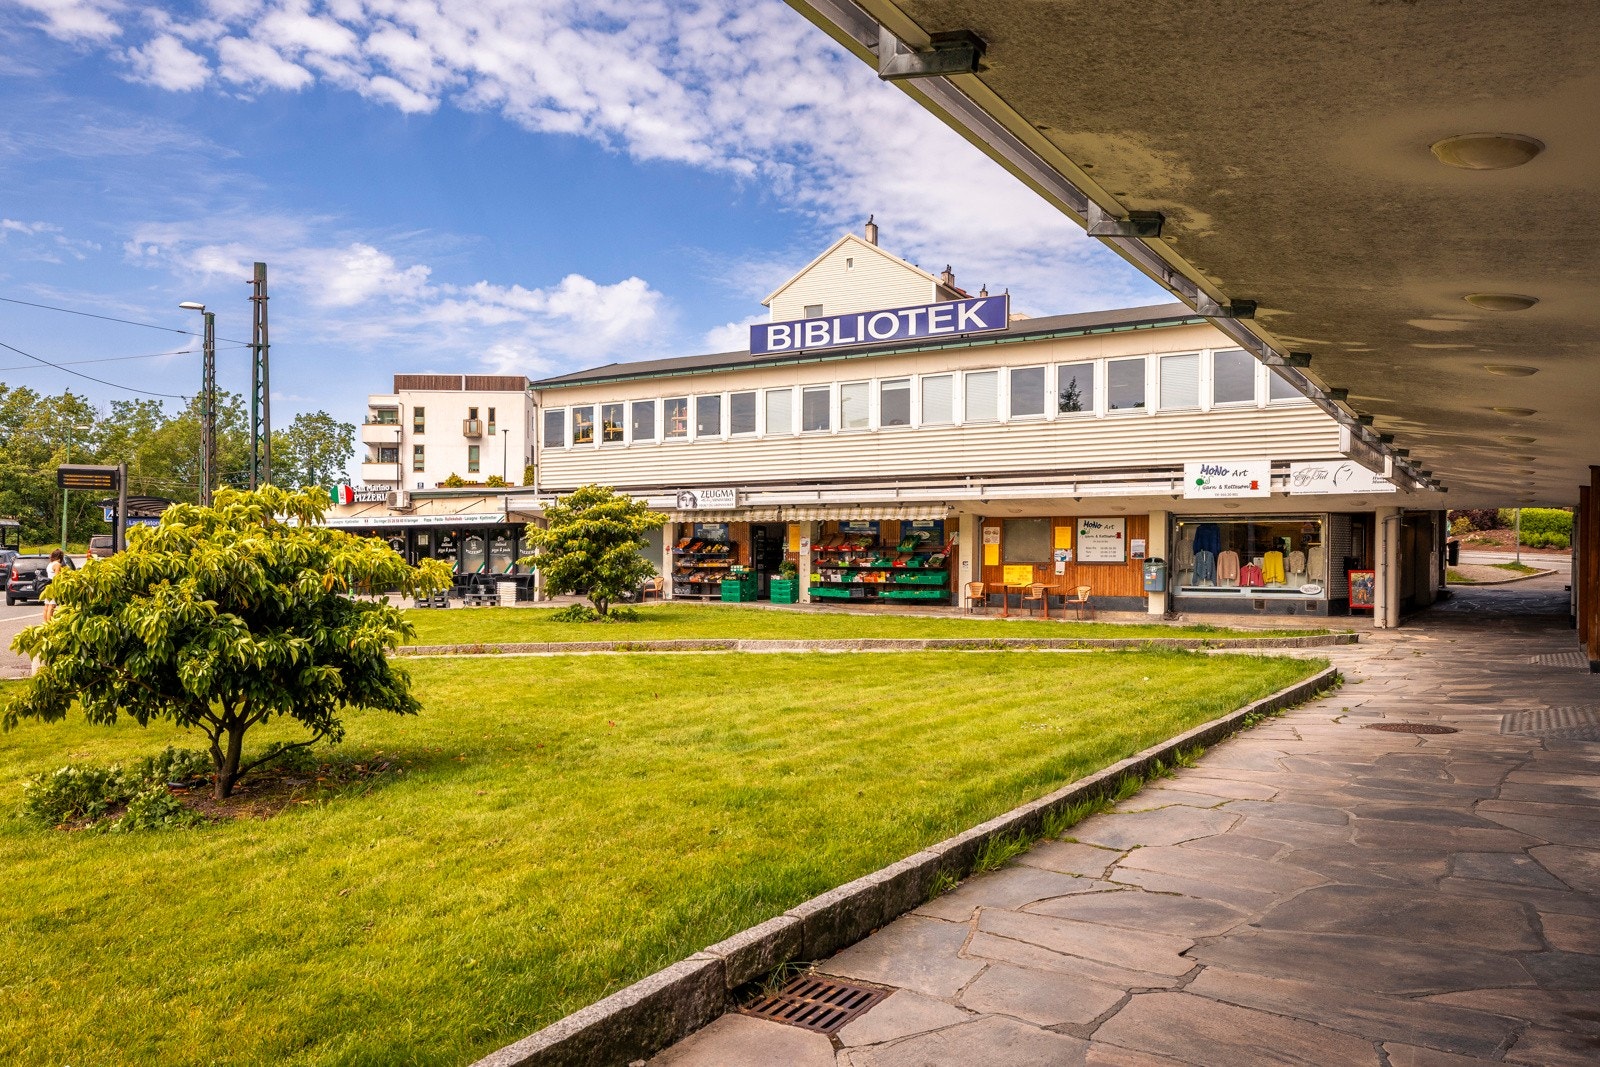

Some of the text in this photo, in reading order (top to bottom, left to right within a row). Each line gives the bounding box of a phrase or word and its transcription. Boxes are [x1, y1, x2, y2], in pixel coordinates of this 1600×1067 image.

[767, 300, 988, 351] BIBLIOTEK
[1232, 469, 1249, 477] Art
[700, 490, 734, 498] ZEUGMA
